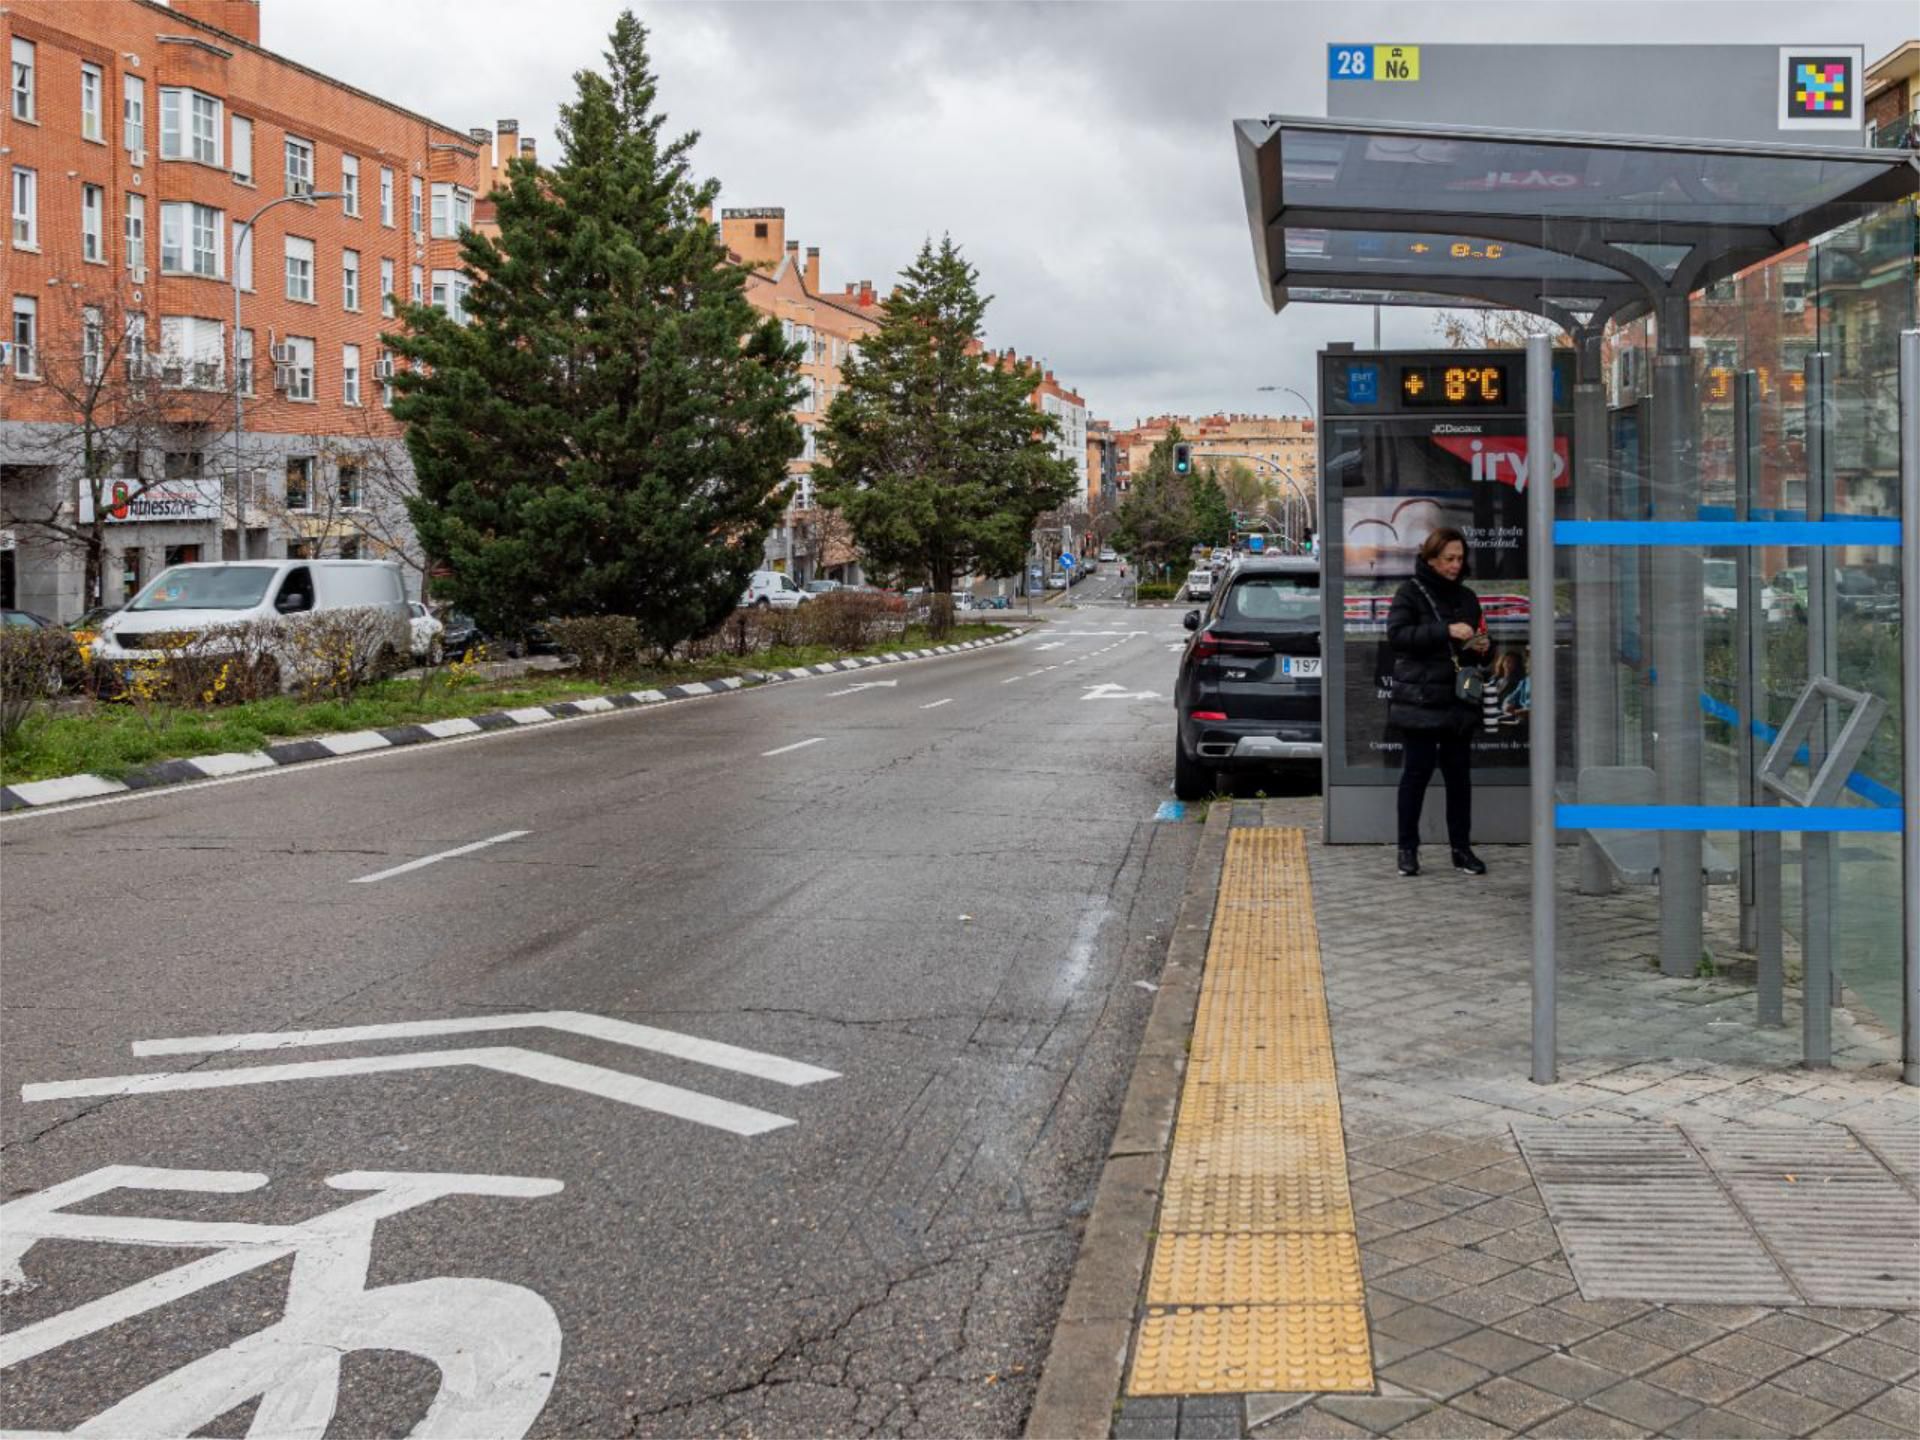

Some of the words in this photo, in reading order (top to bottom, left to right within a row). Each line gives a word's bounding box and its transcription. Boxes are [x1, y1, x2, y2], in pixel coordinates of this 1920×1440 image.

[1337, 51, 1365, 74] 28
[1385, 60, 1409, 78] N6
[1445, 368, 1498, 399] 8°C
